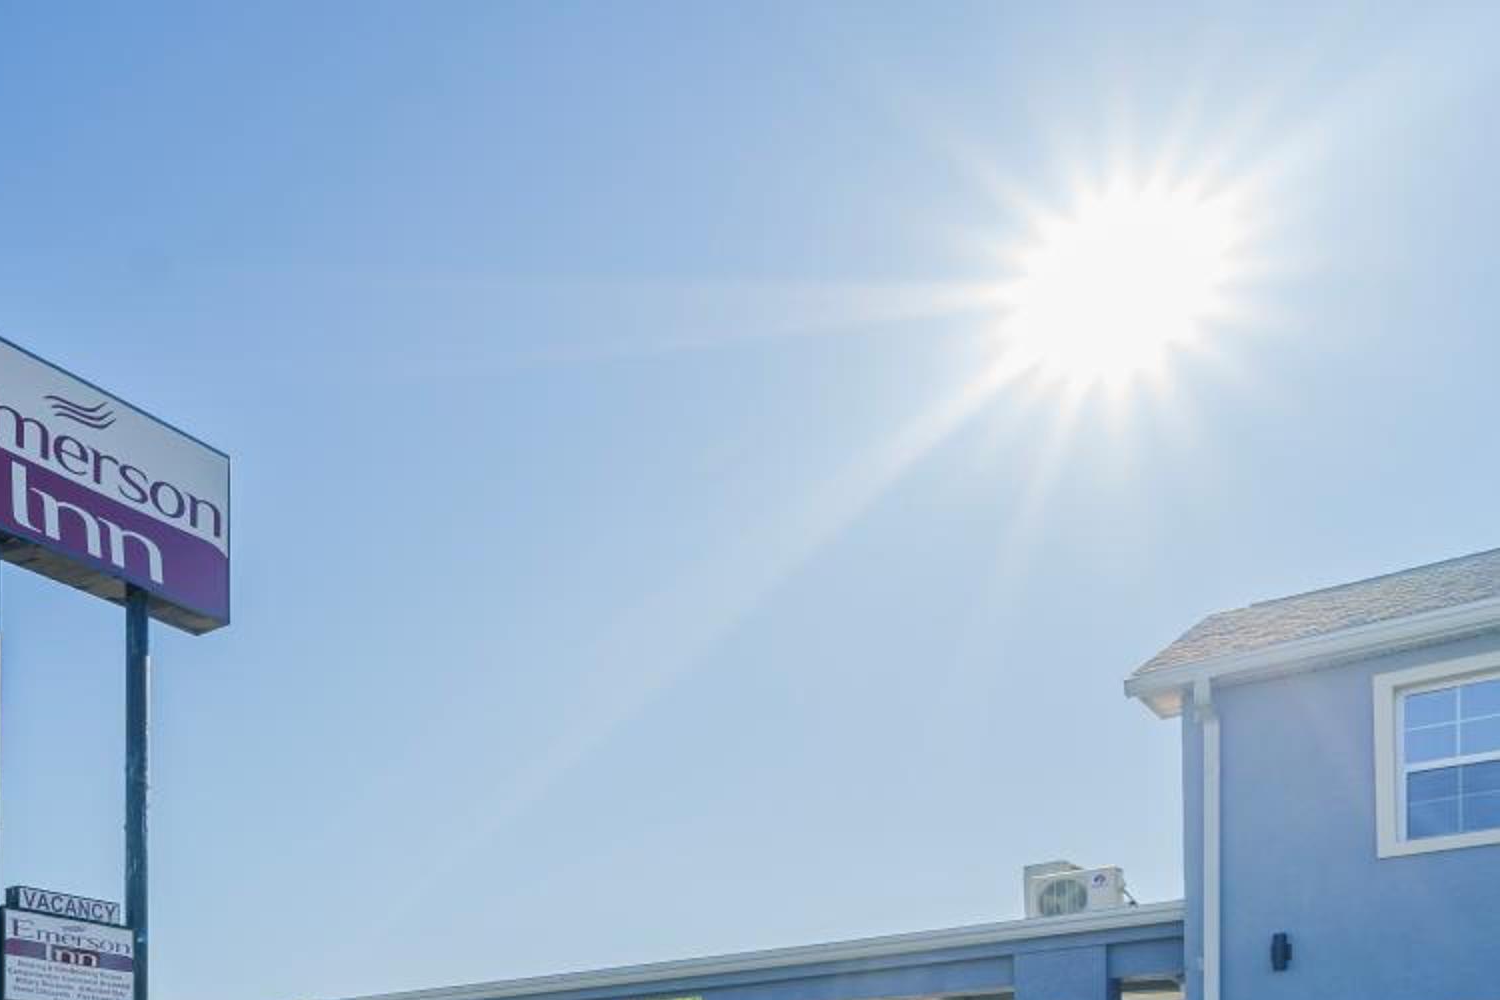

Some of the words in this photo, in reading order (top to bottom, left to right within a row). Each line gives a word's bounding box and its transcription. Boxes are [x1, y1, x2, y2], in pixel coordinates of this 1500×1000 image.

[12, 461, 164, 586] Inn
[23, 890, 117, 920] VACANCY
[11, 918, 132, 954] Emerson
[46, 943, 98, 968] Inn
